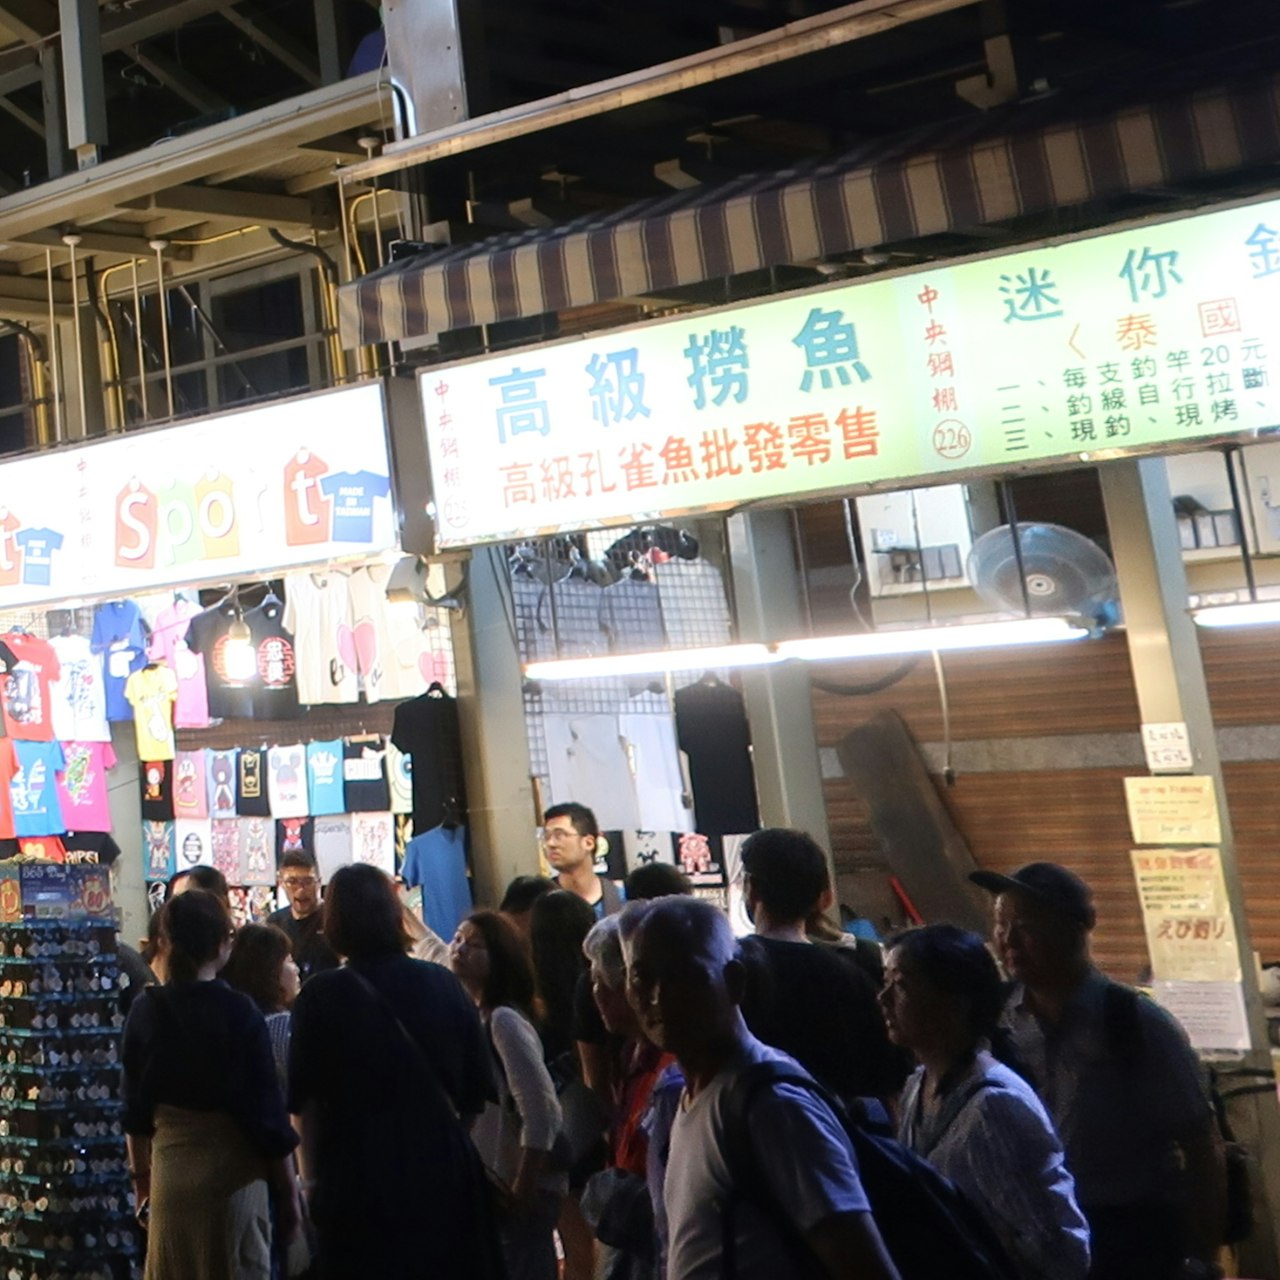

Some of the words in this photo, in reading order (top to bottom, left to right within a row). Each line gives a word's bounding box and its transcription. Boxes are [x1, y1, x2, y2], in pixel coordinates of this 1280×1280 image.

[488, 308, 872, 445] 高級撈魚
[917, 284, 958, 412] 中央鋼棚
[498, 404, 881, 509] 高級孔雀魚批發零售
